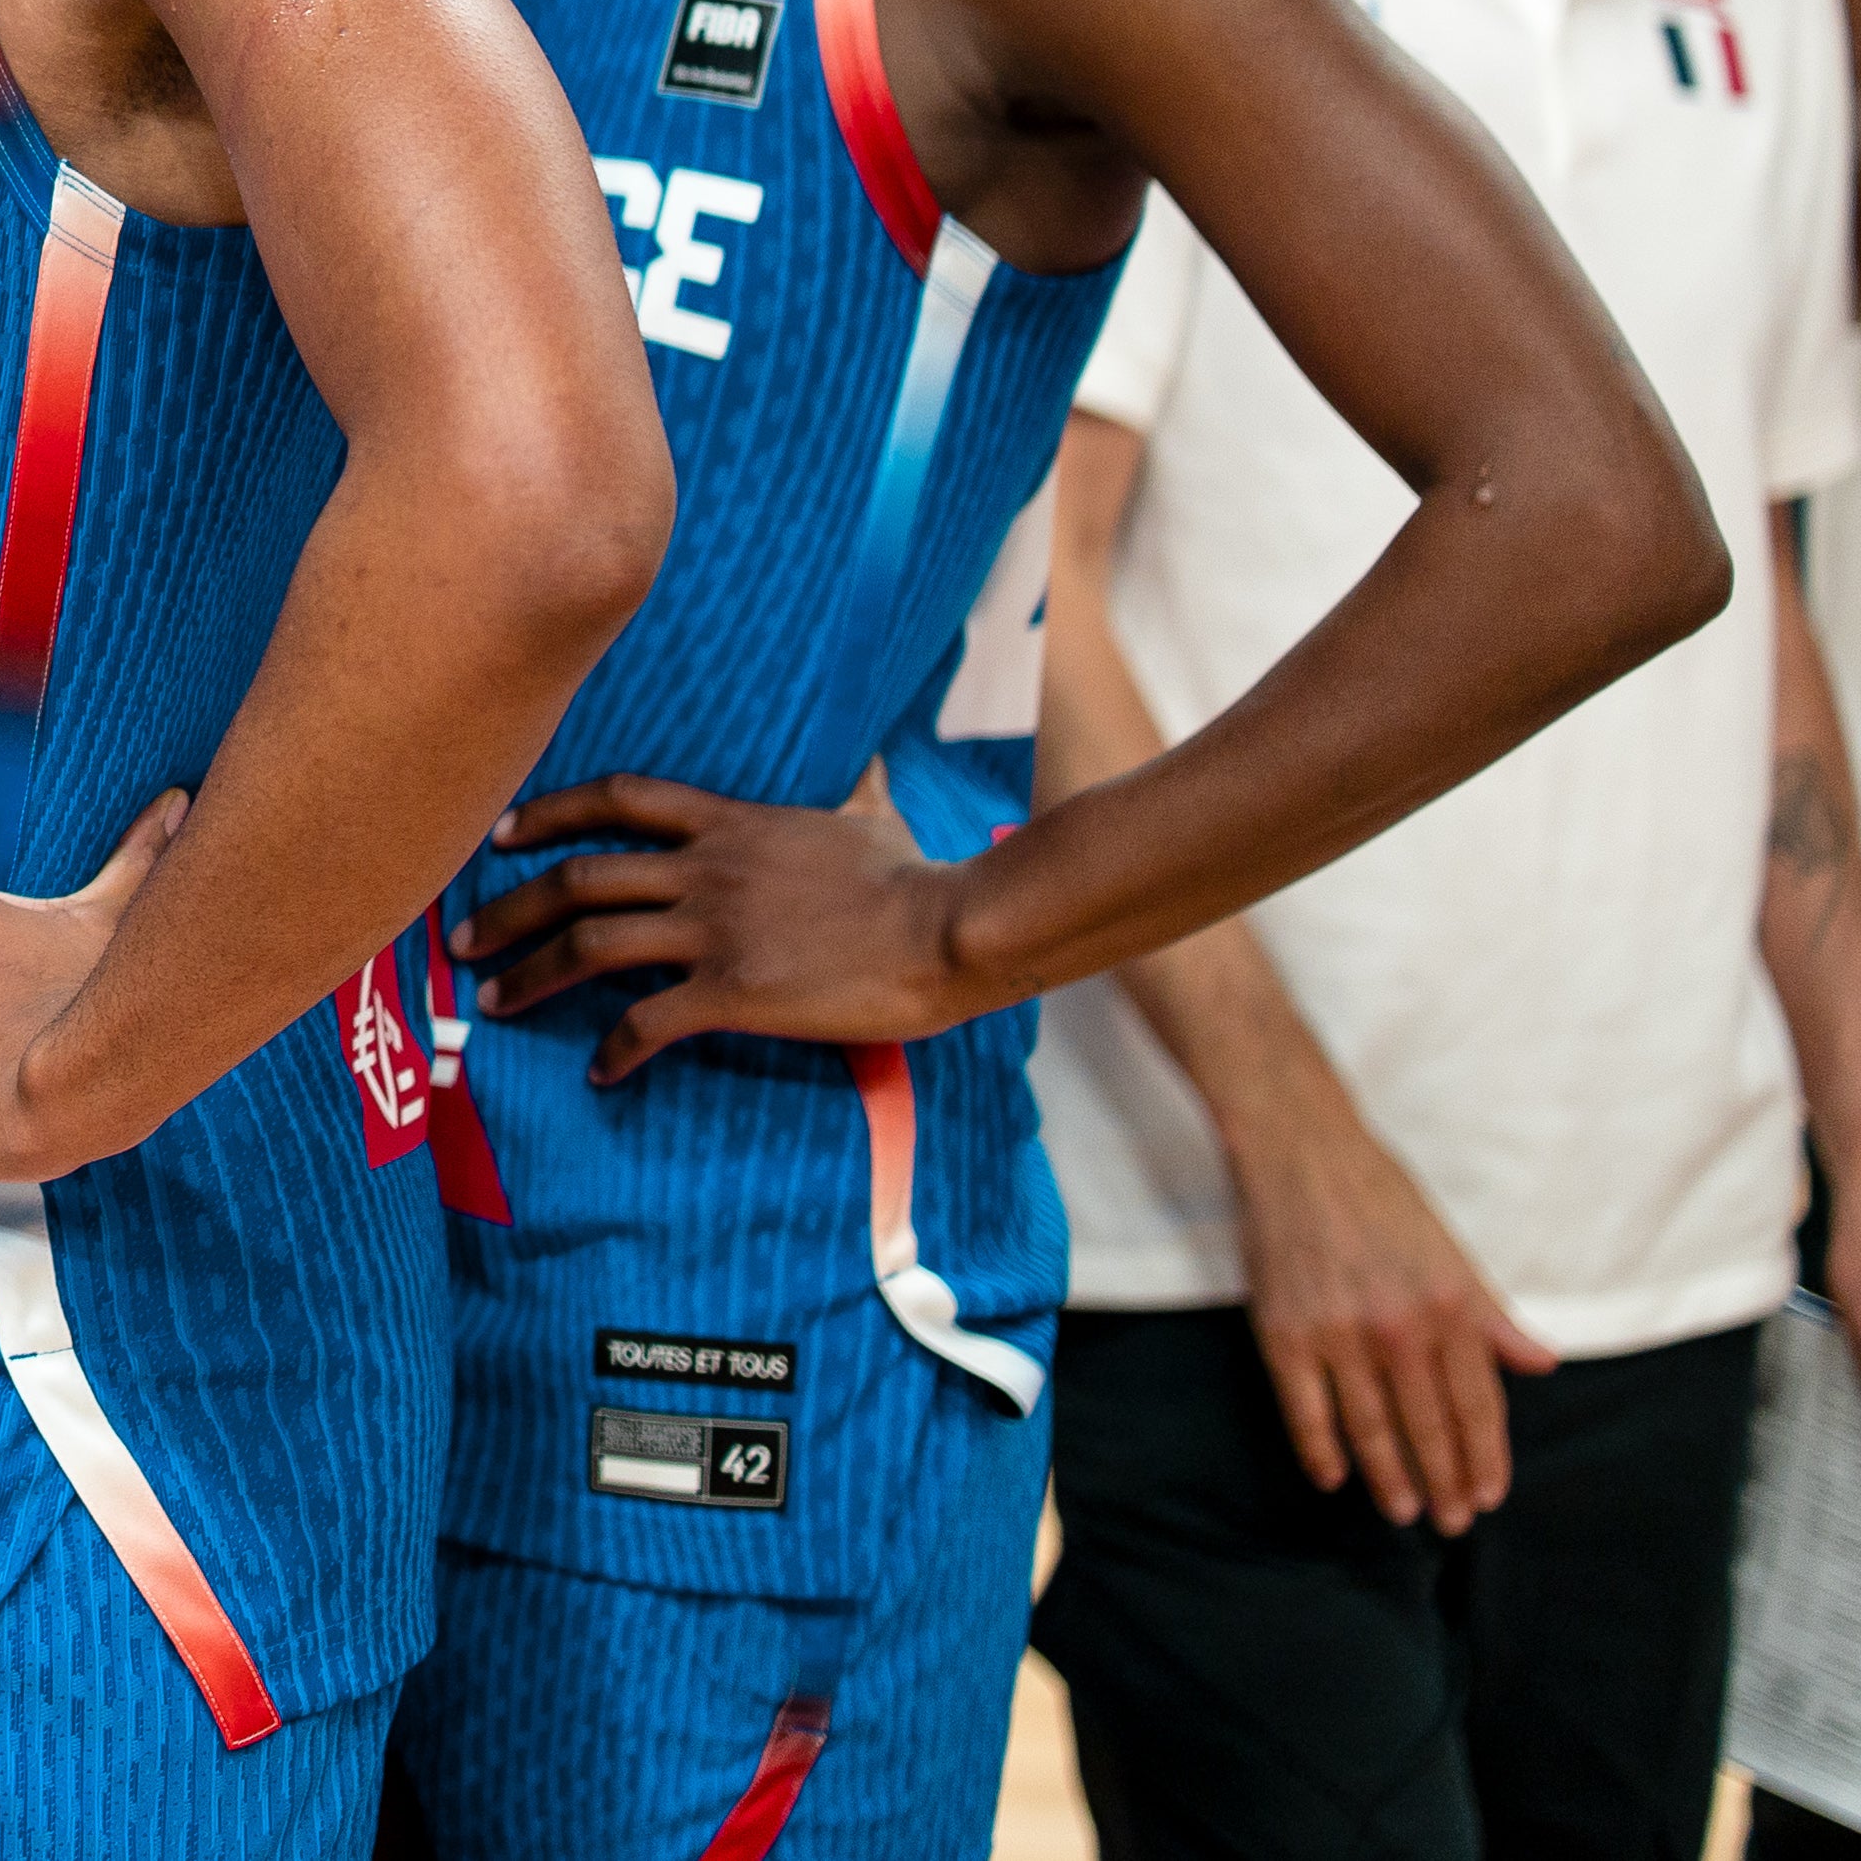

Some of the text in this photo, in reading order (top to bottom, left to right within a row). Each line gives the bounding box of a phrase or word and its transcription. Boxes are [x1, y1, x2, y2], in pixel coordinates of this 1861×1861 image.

[607, 1339, 789, 1381] TOUTES ET TOUS
[719, 1443, 773, 1485] 42
